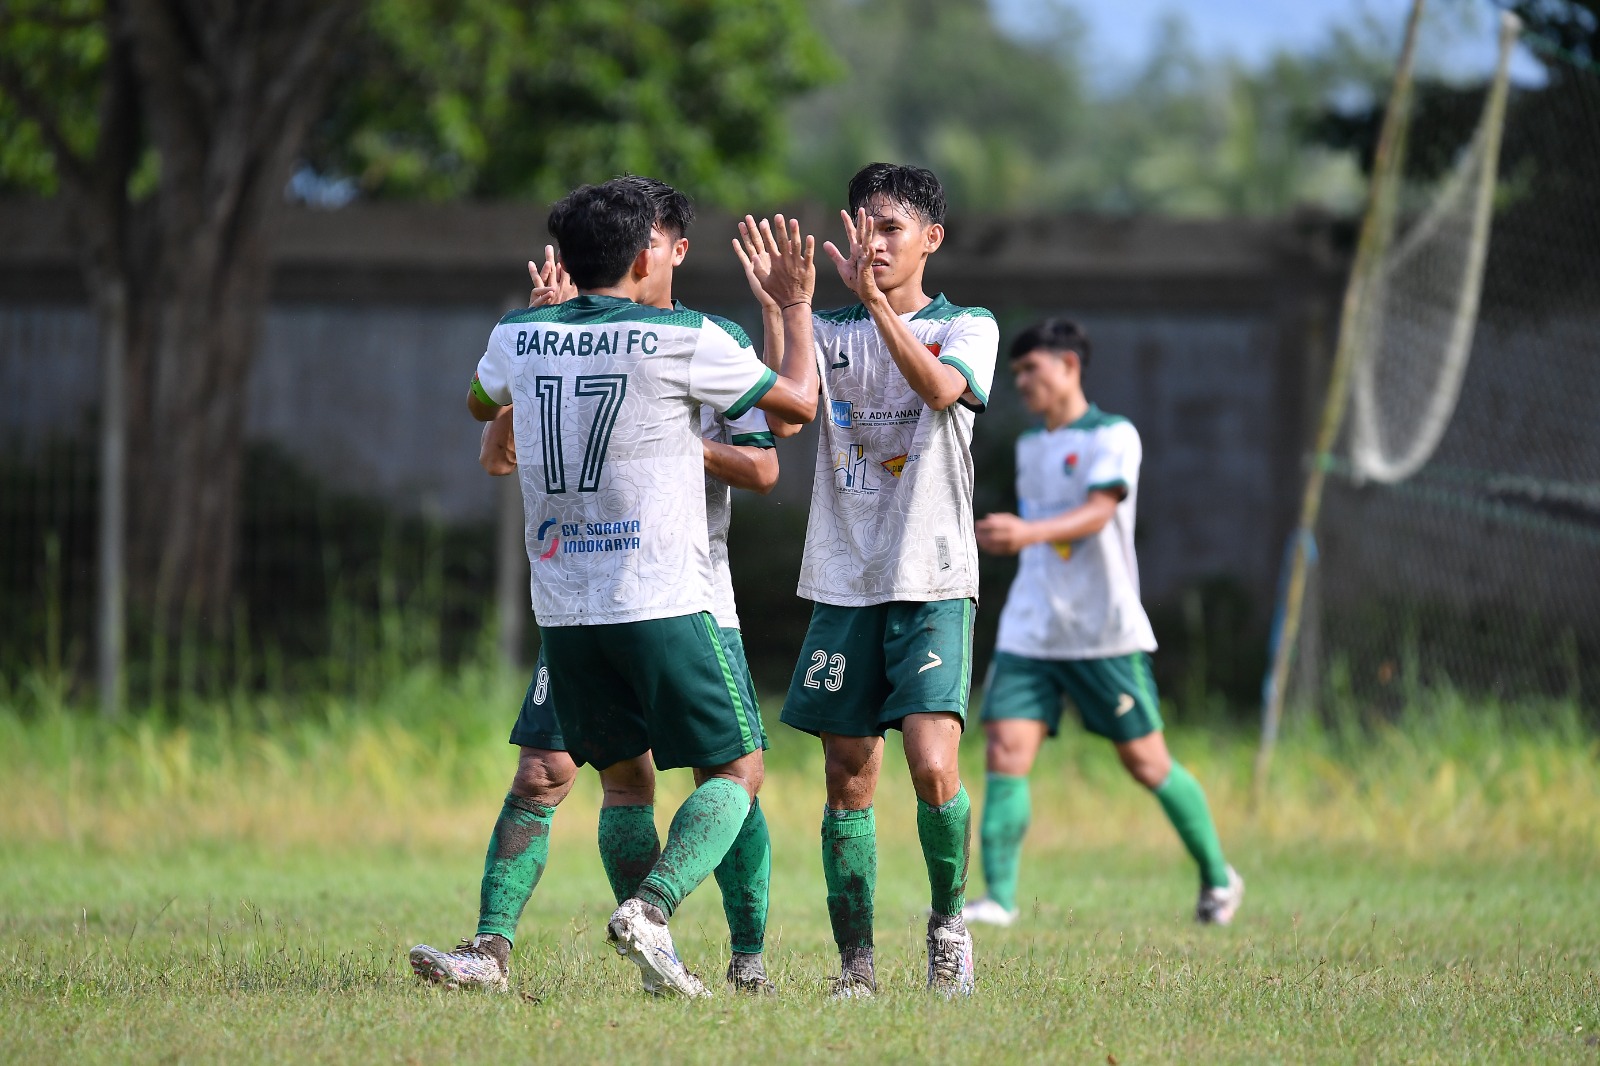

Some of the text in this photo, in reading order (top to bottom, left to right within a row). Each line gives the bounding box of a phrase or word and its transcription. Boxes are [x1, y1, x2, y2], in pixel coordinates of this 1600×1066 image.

[517, 330, 659, 356] BARABAI FC
[853, 411, 866, 420] CV.
[869, 411, 893, 420] ADYA
[536, 374, 627, 495] 17
[562, 520, 640, 537] CV. SORAYA
[564, 537, 640, 553] INDOKARYA
[804, 650, 846, 692] 23
[534, 666, 549, 706] 8
